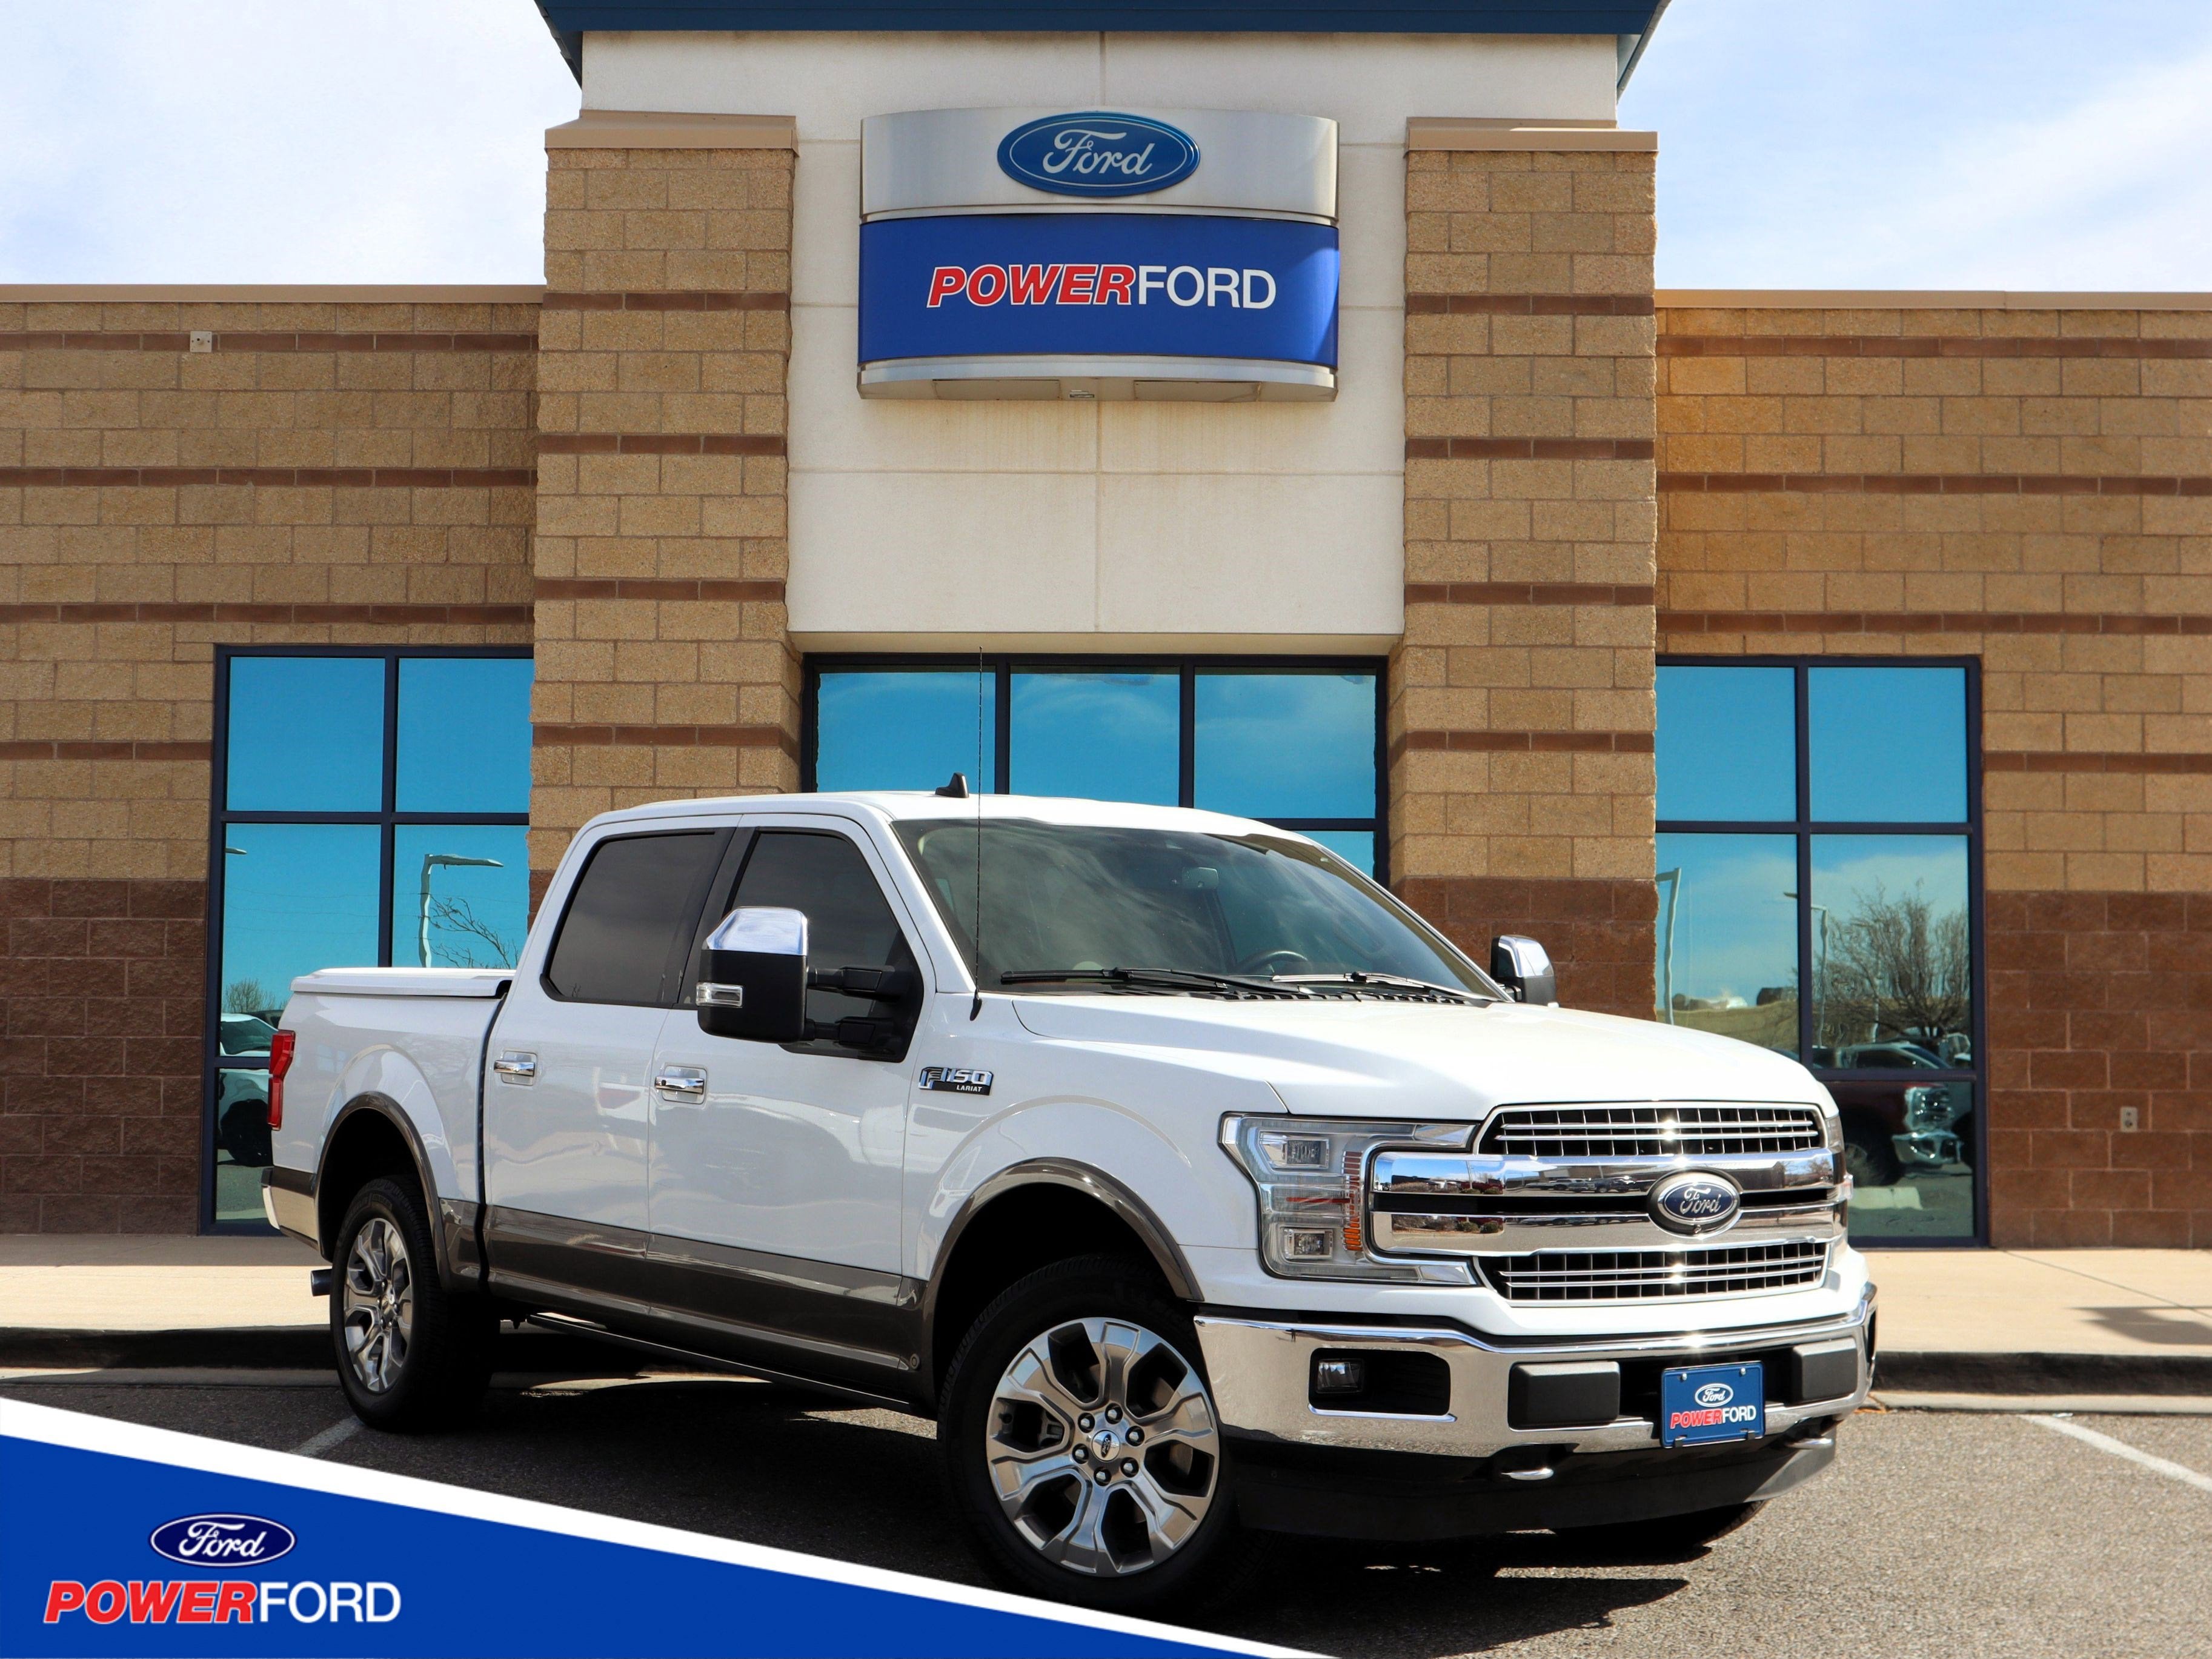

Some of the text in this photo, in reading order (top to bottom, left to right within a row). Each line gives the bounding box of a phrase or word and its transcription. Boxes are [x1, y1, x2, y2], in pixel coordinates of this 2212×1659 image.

[1043, 128, 1155, 175] Ford
[1679, 1186, 1721, 1215] Ford
[1702, 1388, 1725, 1403] Ford
